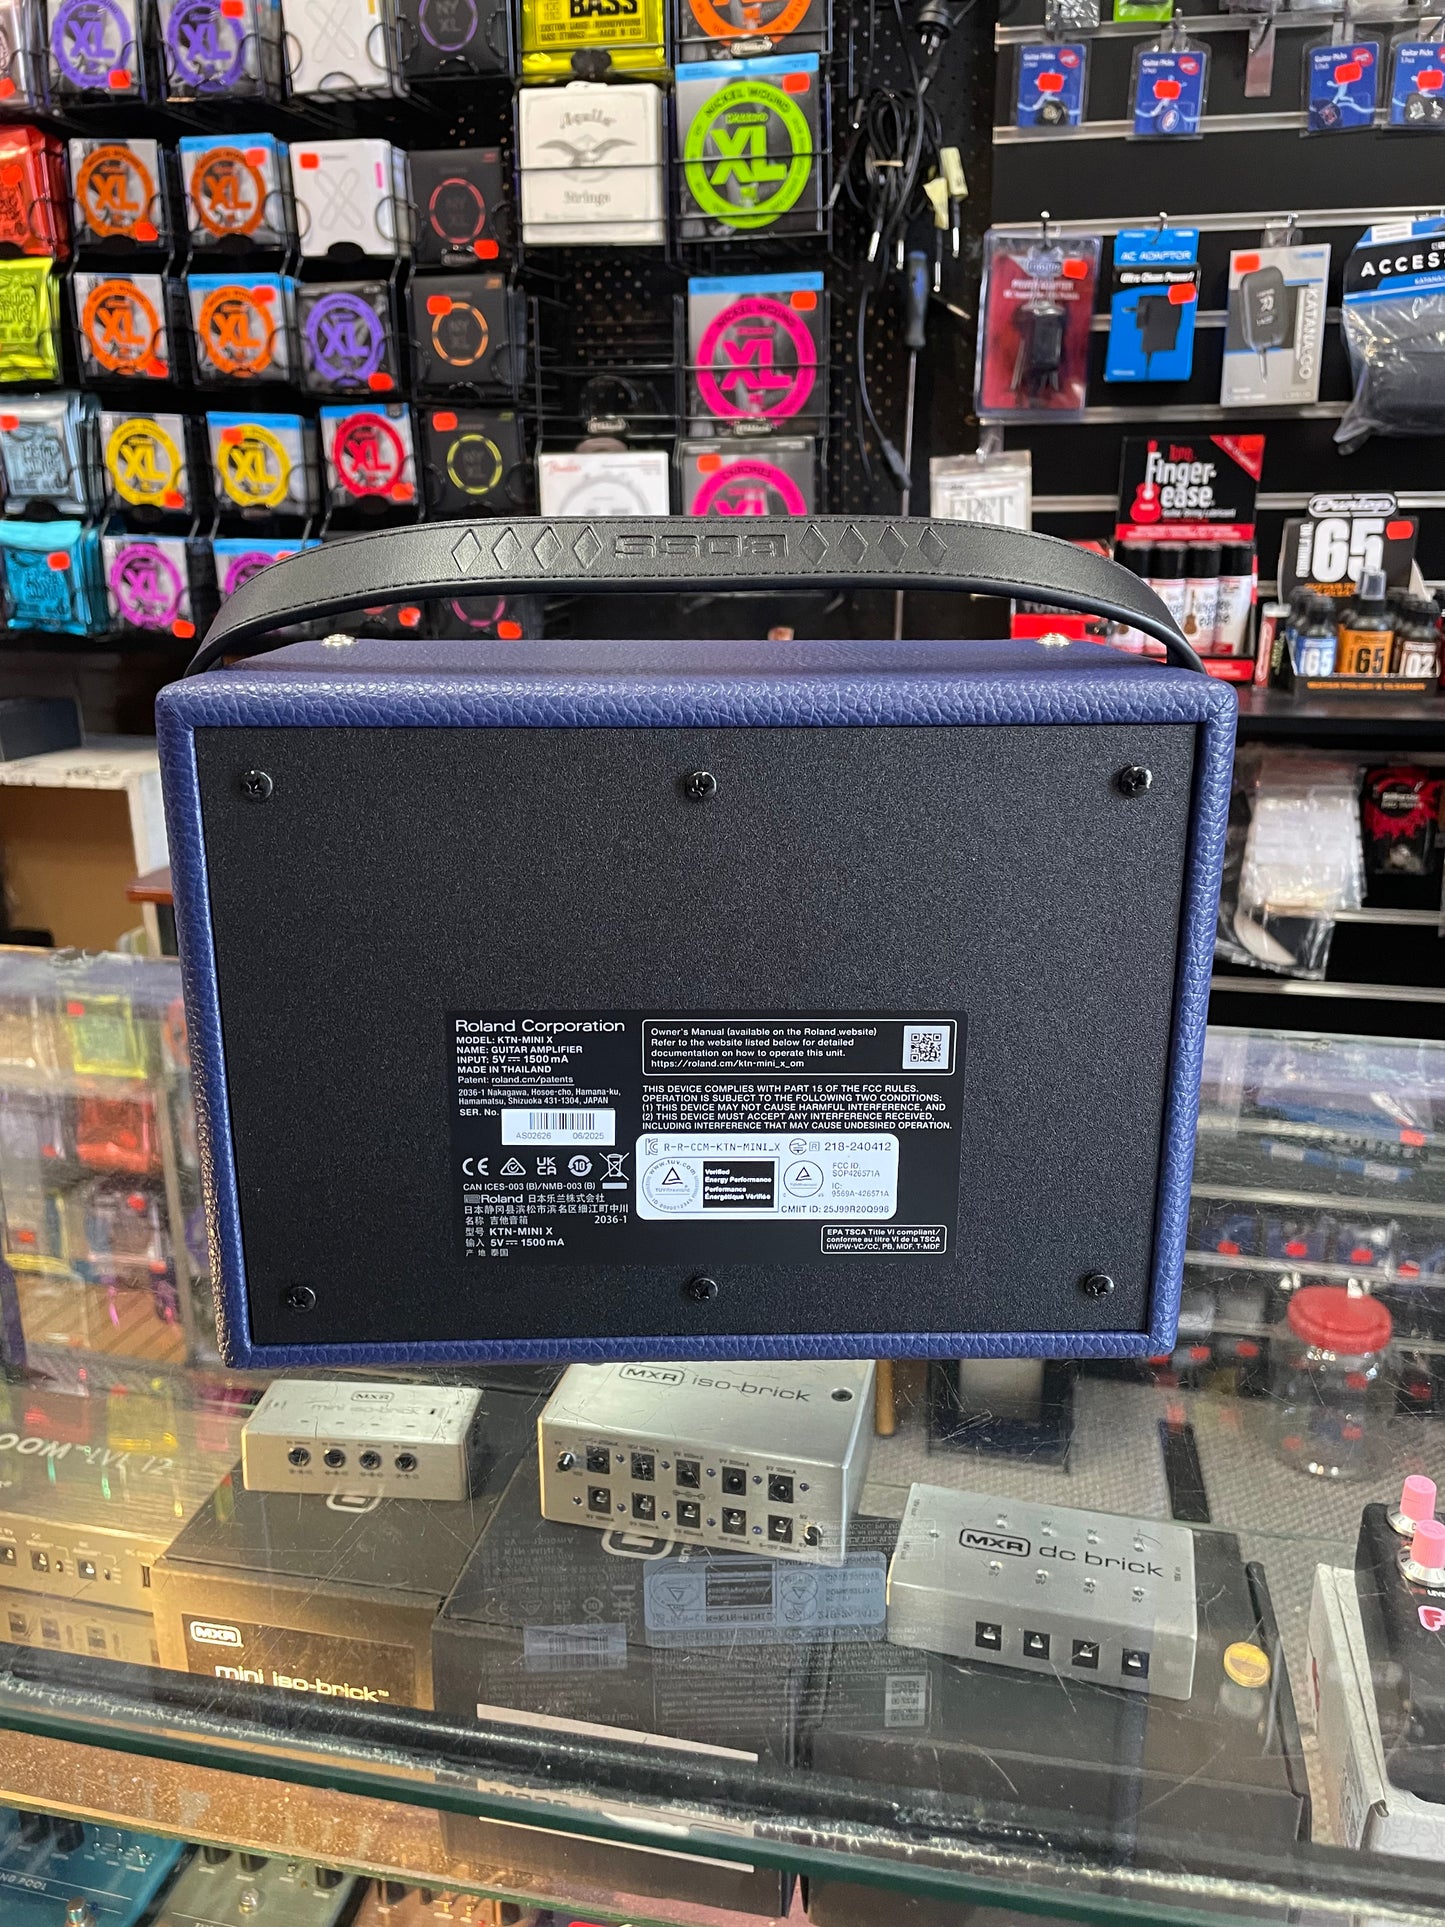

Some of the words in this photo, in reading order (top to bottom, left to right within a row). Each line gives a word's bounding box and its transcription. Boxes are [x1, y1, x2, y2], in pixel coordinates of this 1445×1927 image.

[67, 20, 116, 58] XL
[181, 23, 232, 60] XL
[710, 125, 787, 185] XL
[92, 174, 139, 210] XL
[205, 175, 252, 210] XL
[1361, 251, 1445, 277] ACCES
[96, 308, 146, 344] XL
[214, 305, 265, 341] XL
[321, 322, 370, 358] XL
[719, 338, 793, 391] XL
[343, 435, 392, 471] XL
[120, 443, 167, 481] XL
[227, 448, 277, 484] XL
[613, 533, 789, 559] BOSS
[1312, 518, 1385, 583] 65
[123, 568, 170, 602] XL
[1355, 648, 1385, 674] 65
[455, 1020, 515, 1032] Roland
[522, 1019, 625, 1034] Corporation
[651, 1028, 688, 1036] Owner's
[691, 1028, 724, 1036] Manual
[727, 1028, 770, 1036] (available
[773, 1028, 784, 1036] on
[787, 1028, 801, 1036] the
[804, 1028, 836, 1036] Roland
[838, 1028, 877, 1036] website)
[456, 1036, 495, 1044] MODEL:
[497, 1036, 544, 1044] KTN-MINI
[546, 1036, 553, 1044] X
[456, 1045, 489, 1054] NAME:
[491, 1045, 528, 1054] GUITAR
[530, 1045, 583, 1054] AMPLIFIER
[651, 1049, 719, 1057] documentation
[722, 1049, 733, 1057] on
[736, 1049, 755, 1057] how
[757, 1049, 766, 1057] to
[769, 1049, 804, 1057] operate
[807, 1049, 823, 1057] this
[826, 1049, 846, 1057] unit.
[457, 1055, 489, 1064] INPUT:
[492, 1055, 506, 1064] 5V
[523, 1055, 549, 1064] 1500
[550, 1055, 569, 1064] mA
[457, 1065, 486, 1074] MADE
[489, 1065, 499, 1074] IN
[501, 1065, 551, 1074] THAILAND
[458, 1075, 489, 1084] Patent:
[491, 1075, 574, 1084] roland.cm/patents
[458, 1088, 485, 1097] 2036-1
[487, 1088, 530, 1097] Nakagawa,
[531, 1088, 573, 1097] Hosoe-cho,
[575, 1088, 621, 1097] Hamana-ku,
[642, 1085, 665, 1093] THIS
[667, 1085, 702, 1093] DEVICE
[704, 1085, 755, 1093] COMPLIES
[757, 1085, 781, 1093] WITH
[784, 1085, 810, 1093] PART
[812, 1085, 823, 1093] 15
[825, 1085, 838, 1093] OF
[841, 1085, 860, 1093] THE
[862, 1085, 882, 1093] FCC
[884, 1085, 919, 1093] RULES.
[458, 1096, 507, 1105] Hamamatsu,
[508, 1096, 542, 1105] Shizuoka
[583, 1096, 608, 1105] JAPAN
[642, 1094, 698, 1102] OPERATION
[700, 1094, 710, 1102] IS
[712, 1094, 756, 1102] SUBJECT
[758, 1094, 771, 1102] TO
[774, 1094, 793, 1102] THE
[796, 1094, 852, 1102] FOLLOWING
[855, 1094, 877, 1102] TWO
[880, 1094, 942, 1102] CONDITIONS:
[572, 1132, 605, 1140] 06/2025
[824, 1142, 892, 1151] 218-240412
[536, 1157, 556, 1166] UK
[574, 1161, 585, 1171] 10
[462, 1158, 489, 1176] CE
[536, 1167, 557, 1176] CA
[463, 1182, 482, 1191] CAN
[484, 1182, 524, 1191] ICES-003
[525, 1182, 582, 1191] (B)/NMB-003
[584, 1182, 596, 1191] (B)
[481, 1194, 523, 1204] Roland
[528, 1193, 605, 1203] 日本乐兰株式会社
[465, 1216, 485, 1226] 名称
[490, 1216, 528, 1226] 吉他音箱
[594, 1216, 627, 1224] 2036-1
[465, 1227, 485, 1237] 型号
[489, 1227, 543, 1236] KTN-MINI
[546, 1227, 553, 1236] X
[465, 1238, 485, 1248] 输入
[490, 1238, 504, 1247] 5V
[521, 1238, 546, 1247] 1500
[547, 1238, 565, 1247] mA
[626, 1368, 678, 1382] MXR
[692, 1375, 812, 1401] iso-brick
[356, 1392, 390, 1401] MXR
[966, 1534, 1024, 1552] MXR
[1039, 1545, 1076, 1561] dc
[1085, 1551, 1165, 1578] brick
[195, 1627, 237, 1642] MXR
[215, 1665, 264, 1684] mini
